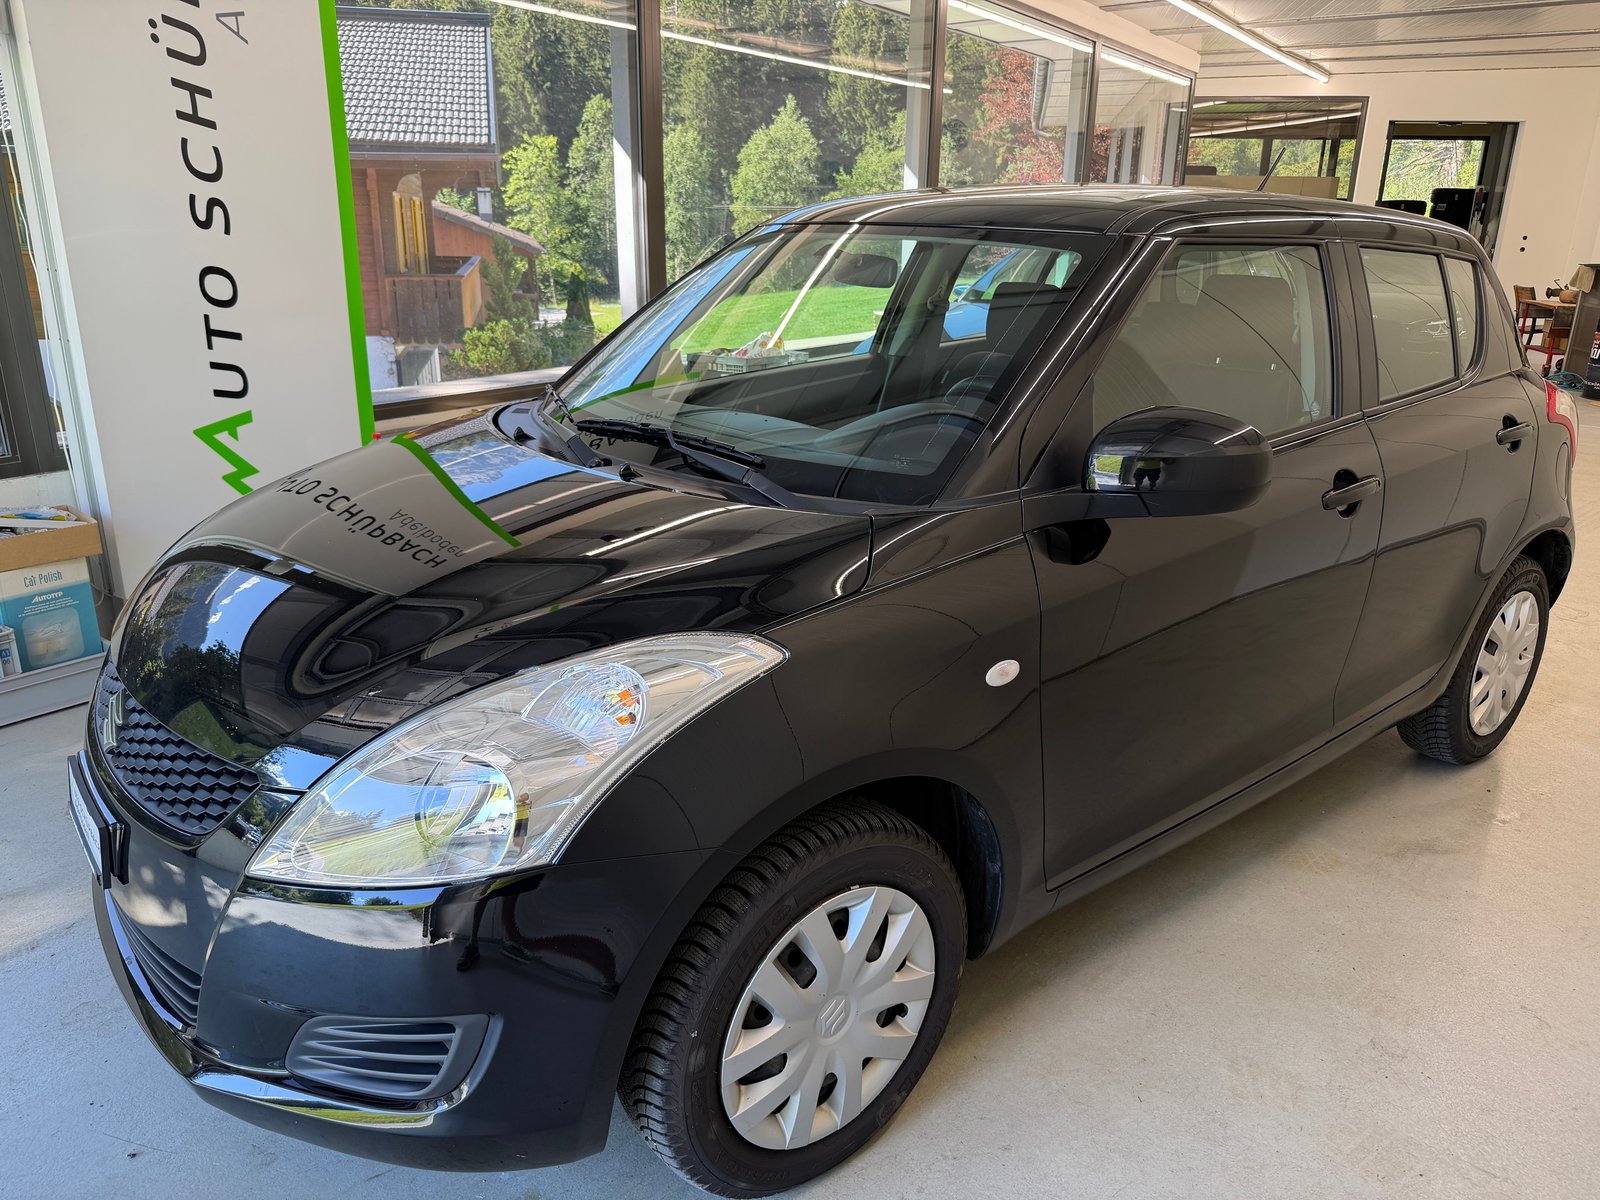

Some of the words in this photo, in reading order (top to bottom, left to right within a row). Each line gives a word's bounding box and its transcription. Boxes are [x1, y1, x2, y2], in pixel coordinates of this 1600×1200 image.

[148, 0, 231, 236] SCHÜ
[23, 575, 37, 588] Car
[38, 570, 63, 585] Polish
